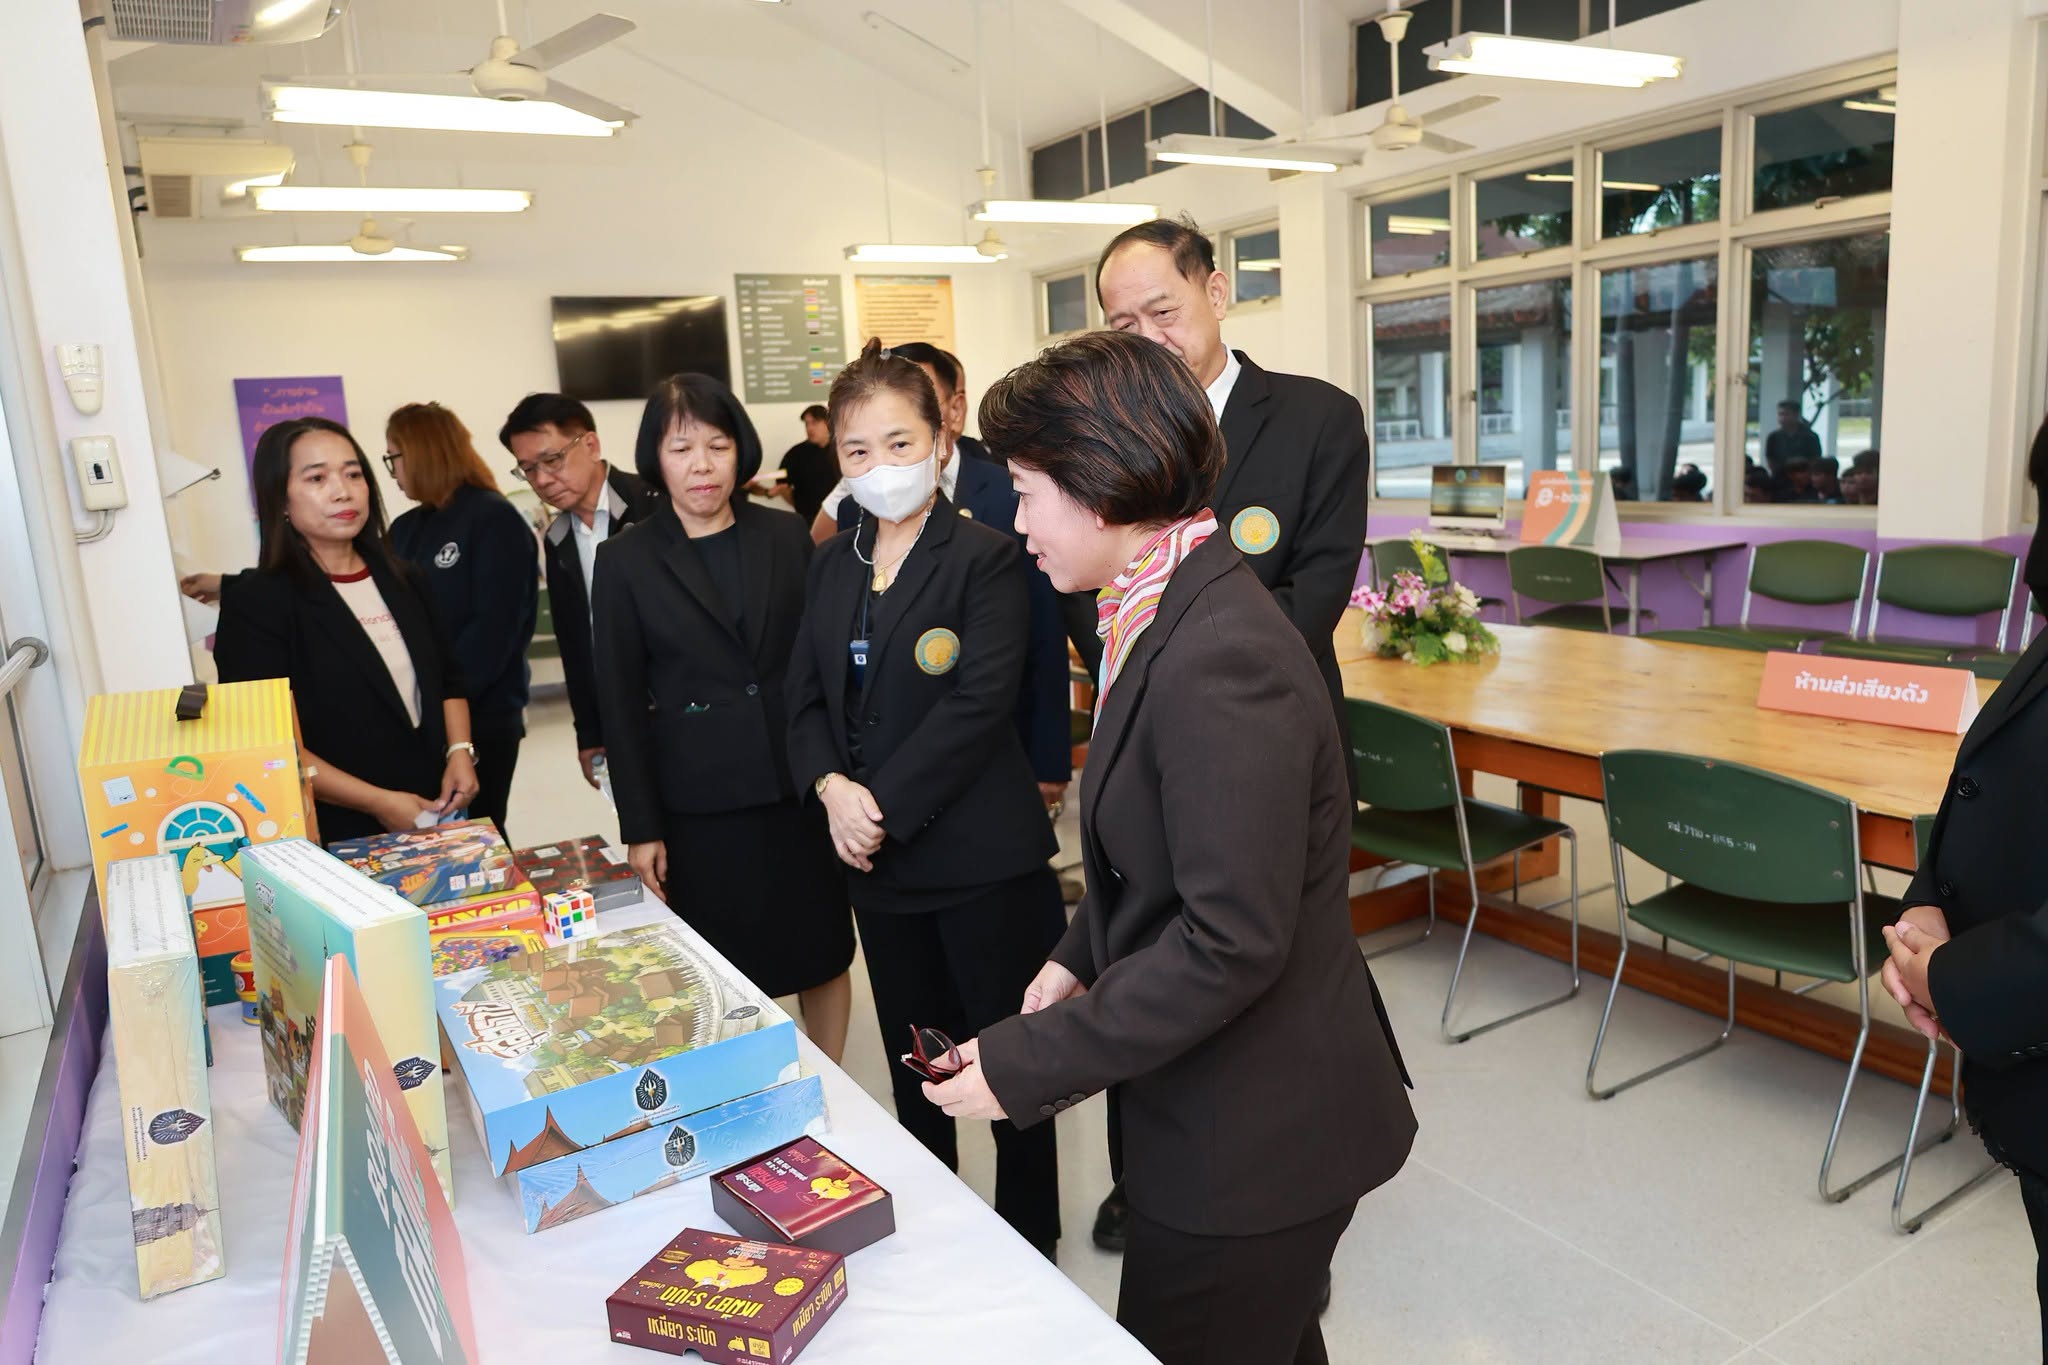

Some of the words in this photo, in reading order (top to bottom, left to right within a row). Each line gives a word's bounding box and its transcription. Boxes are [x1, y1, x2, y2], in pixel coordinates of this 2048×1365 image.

[1794, 671, 1928, 704] ห้ามส่งเสียงดัง
[429, 899, 531, 930] INGO
[363, 1057, 390, 1230] BOARD
[385, 1097, 444, 1363] GAME
[659, 1285, 708, 1306] ระเบิด
[704, 1294, 764, 1319] เหมียว
[792, 1305, 815, 1338] เหมียว
[815, 1281, 833, 1311] ระเบิด
[647, 1315, 683, 1340] เหมียว
[687, 1323, 718, 1347] ระเบิด
